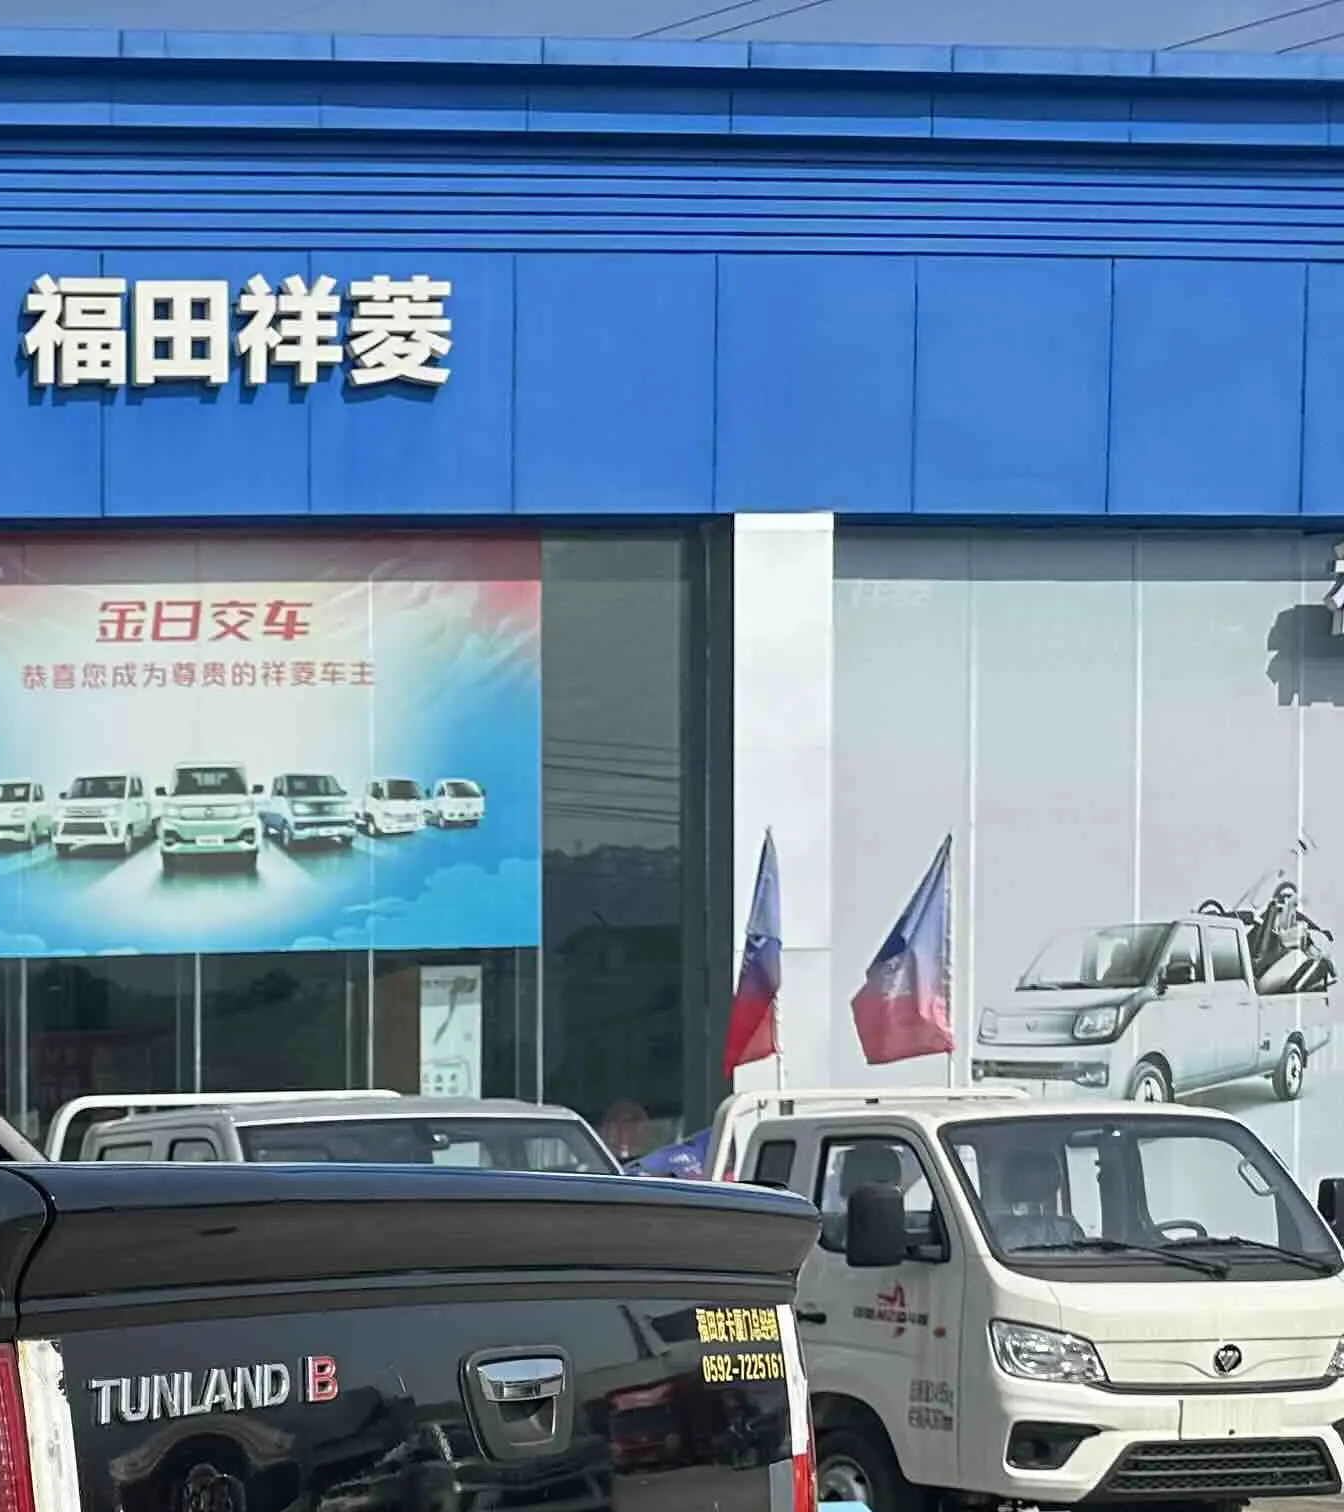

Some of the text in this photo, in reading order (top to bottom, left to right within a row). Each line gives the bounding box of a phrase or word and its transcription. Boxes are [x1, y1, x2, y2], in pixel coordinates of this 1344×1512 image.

[24, 273, 452, 387] 福田祥菱
[95, 600, 314, 642] 金日交车
[21, 661, 377, 690] 恭喜您成为尊贵的祥菱车主
[703, 1352, 784, 1382] 0592-7225161
[88, 1354, 338, 1425] TUNLAND B
